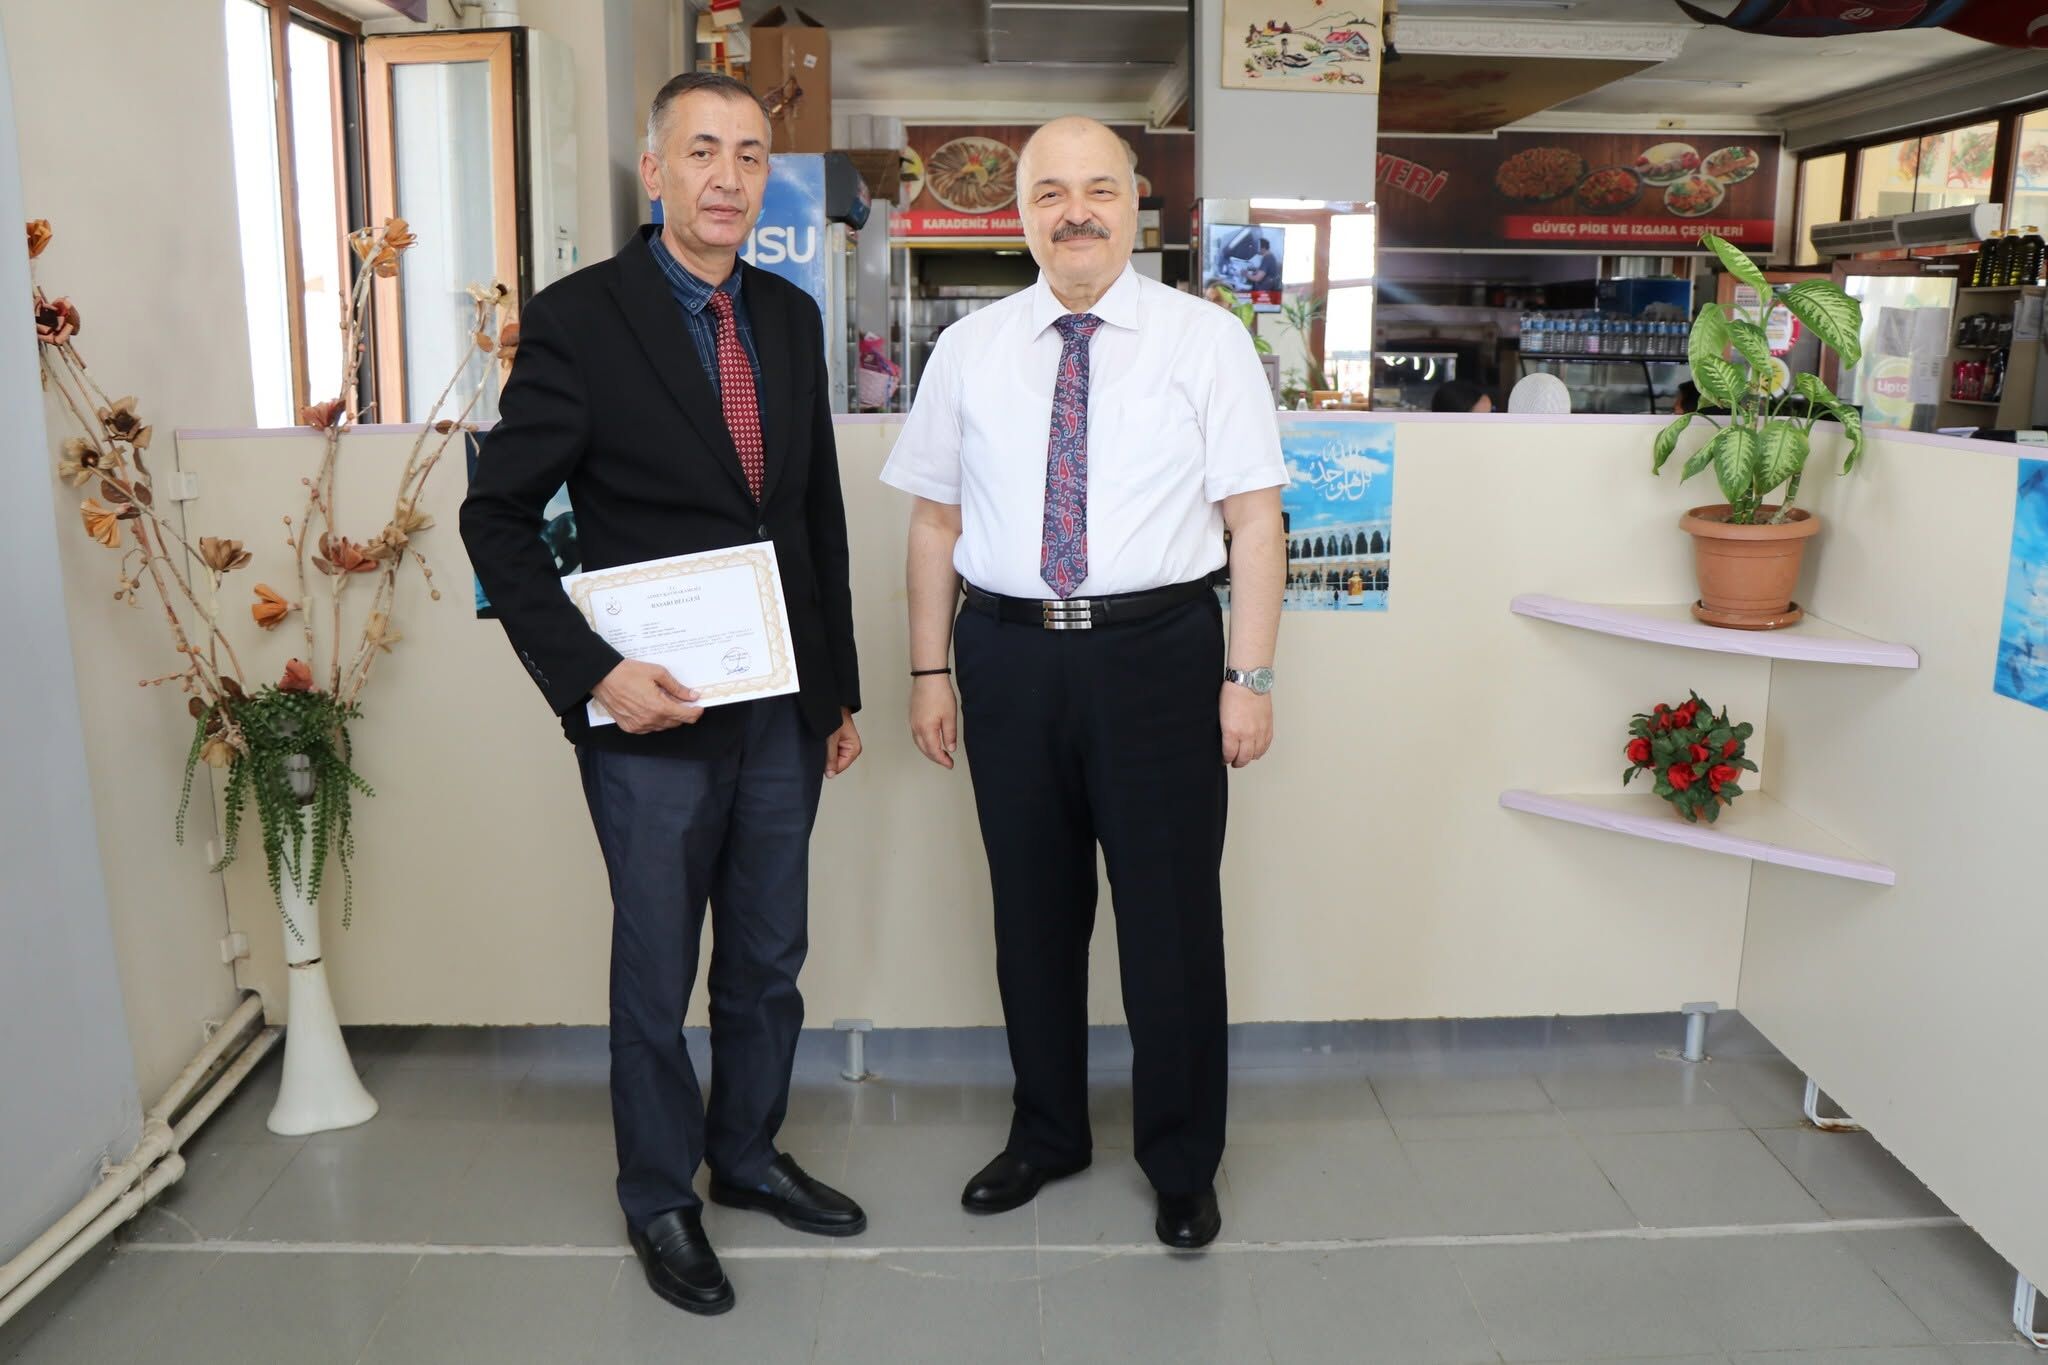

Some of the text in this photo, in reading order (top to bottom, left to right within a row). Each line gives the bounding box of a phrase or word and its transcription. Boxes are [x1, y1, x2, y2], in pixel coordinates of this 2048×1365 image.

[923, 217, 989, 230] KARADENİZ
[1532, 220, 1576, 237] GÜVEÇ
[1579, 221, 1609, 235] PİDE
[1612, 223, 1628, 235] VE
[1632, 224, 1677, 236] IZGARA
